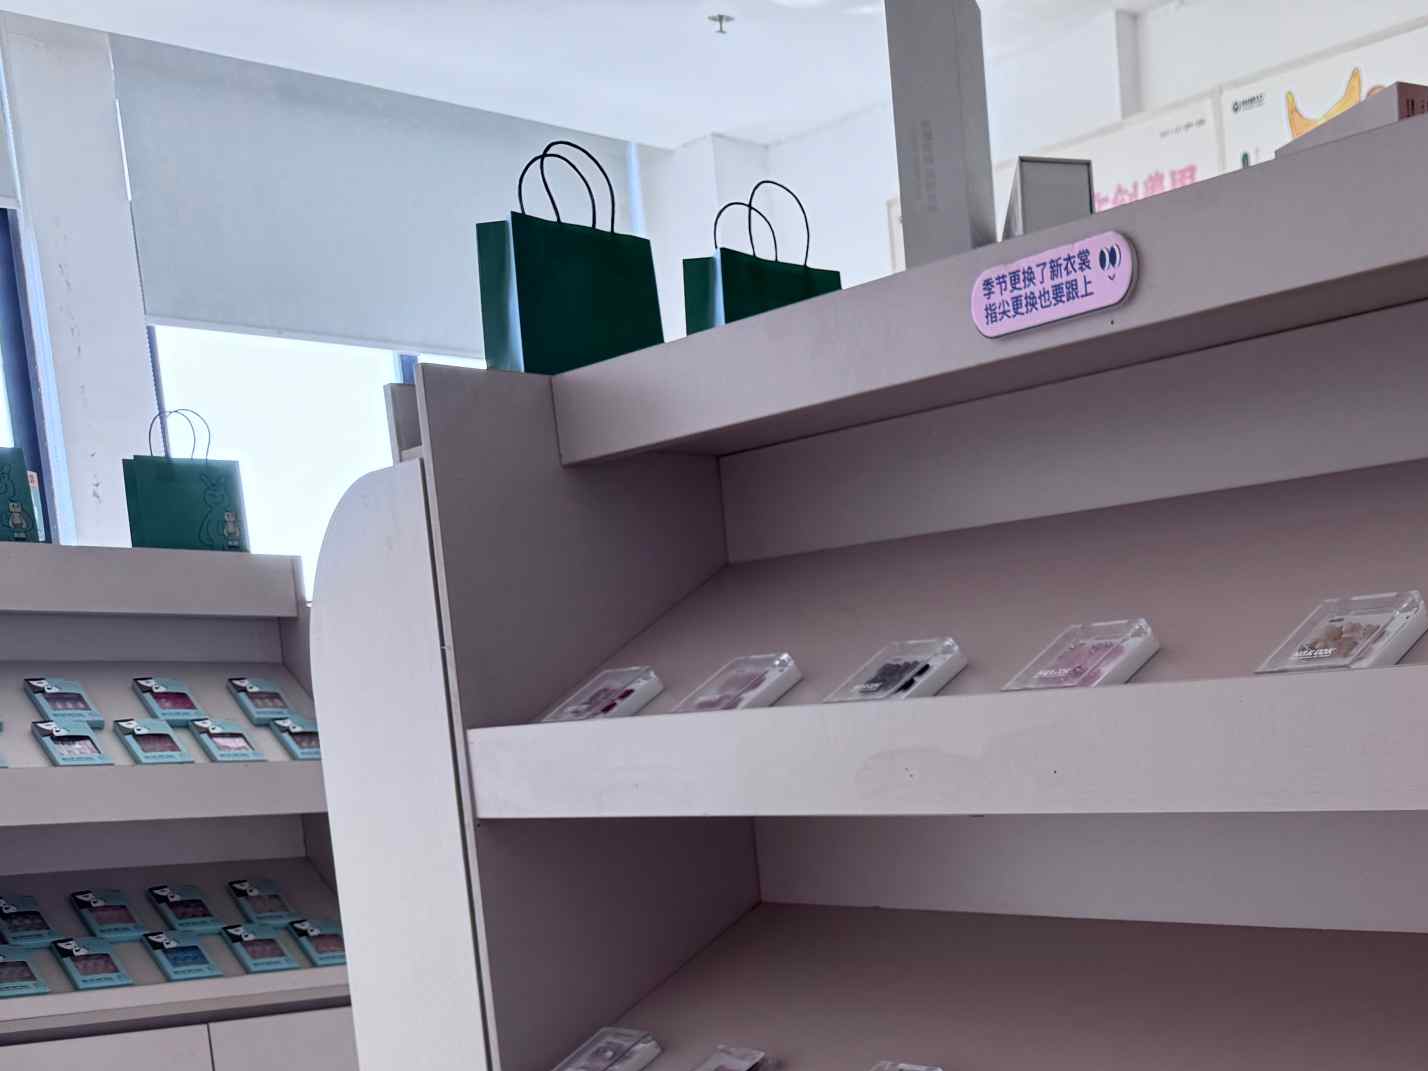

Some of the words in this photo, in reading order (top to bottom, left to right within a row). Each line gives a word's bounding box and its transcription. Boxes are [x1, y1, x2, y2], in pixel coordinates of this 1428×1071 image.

[982, 249, 1092, 300] 季节更换了新衣裳
[984, 275, 1095, 325] 指尖更换也要跟上
